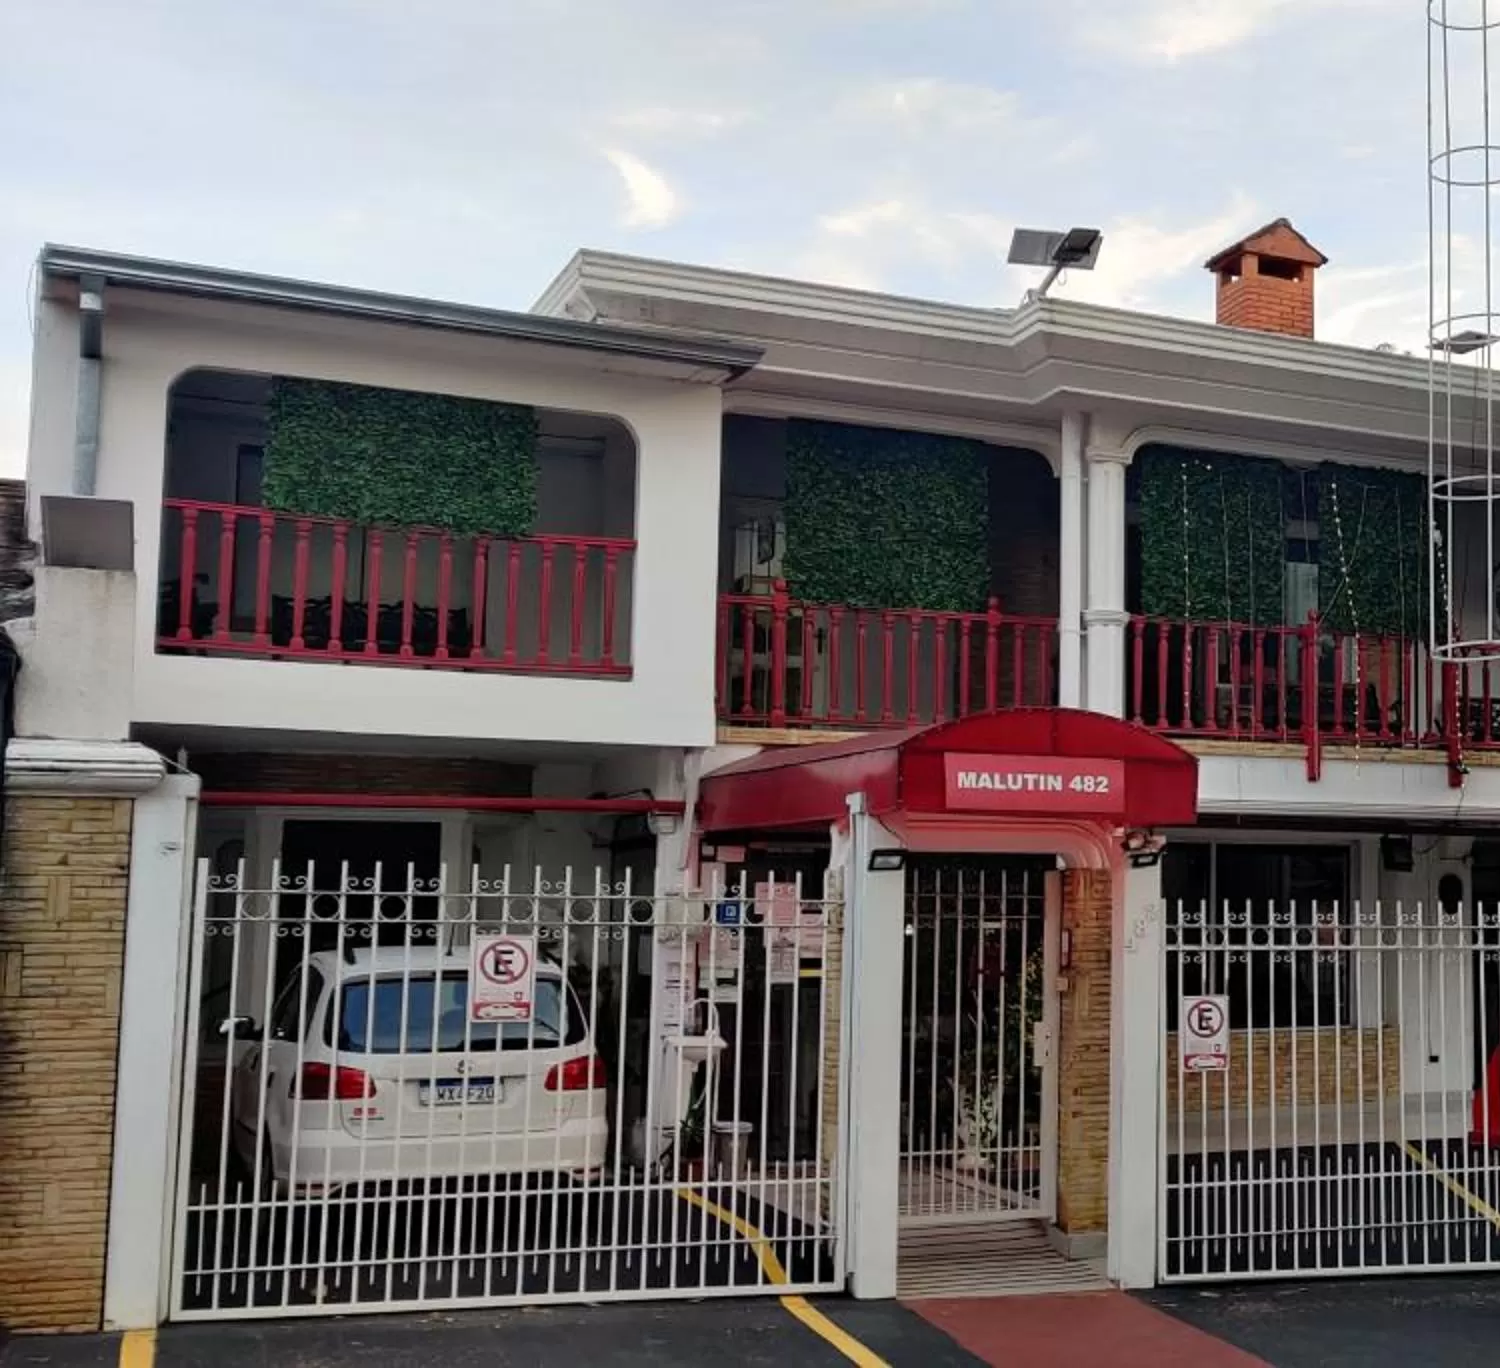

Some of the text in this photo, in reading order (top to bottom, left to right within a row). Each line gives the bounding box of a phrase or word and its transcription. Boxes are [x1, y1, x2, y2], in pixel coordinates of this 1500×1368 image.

[957, 771, 1109, 793] MALUTIN 482
[494, 950, 514, 975] E
[1197, 1007, 1213, 1031] E
